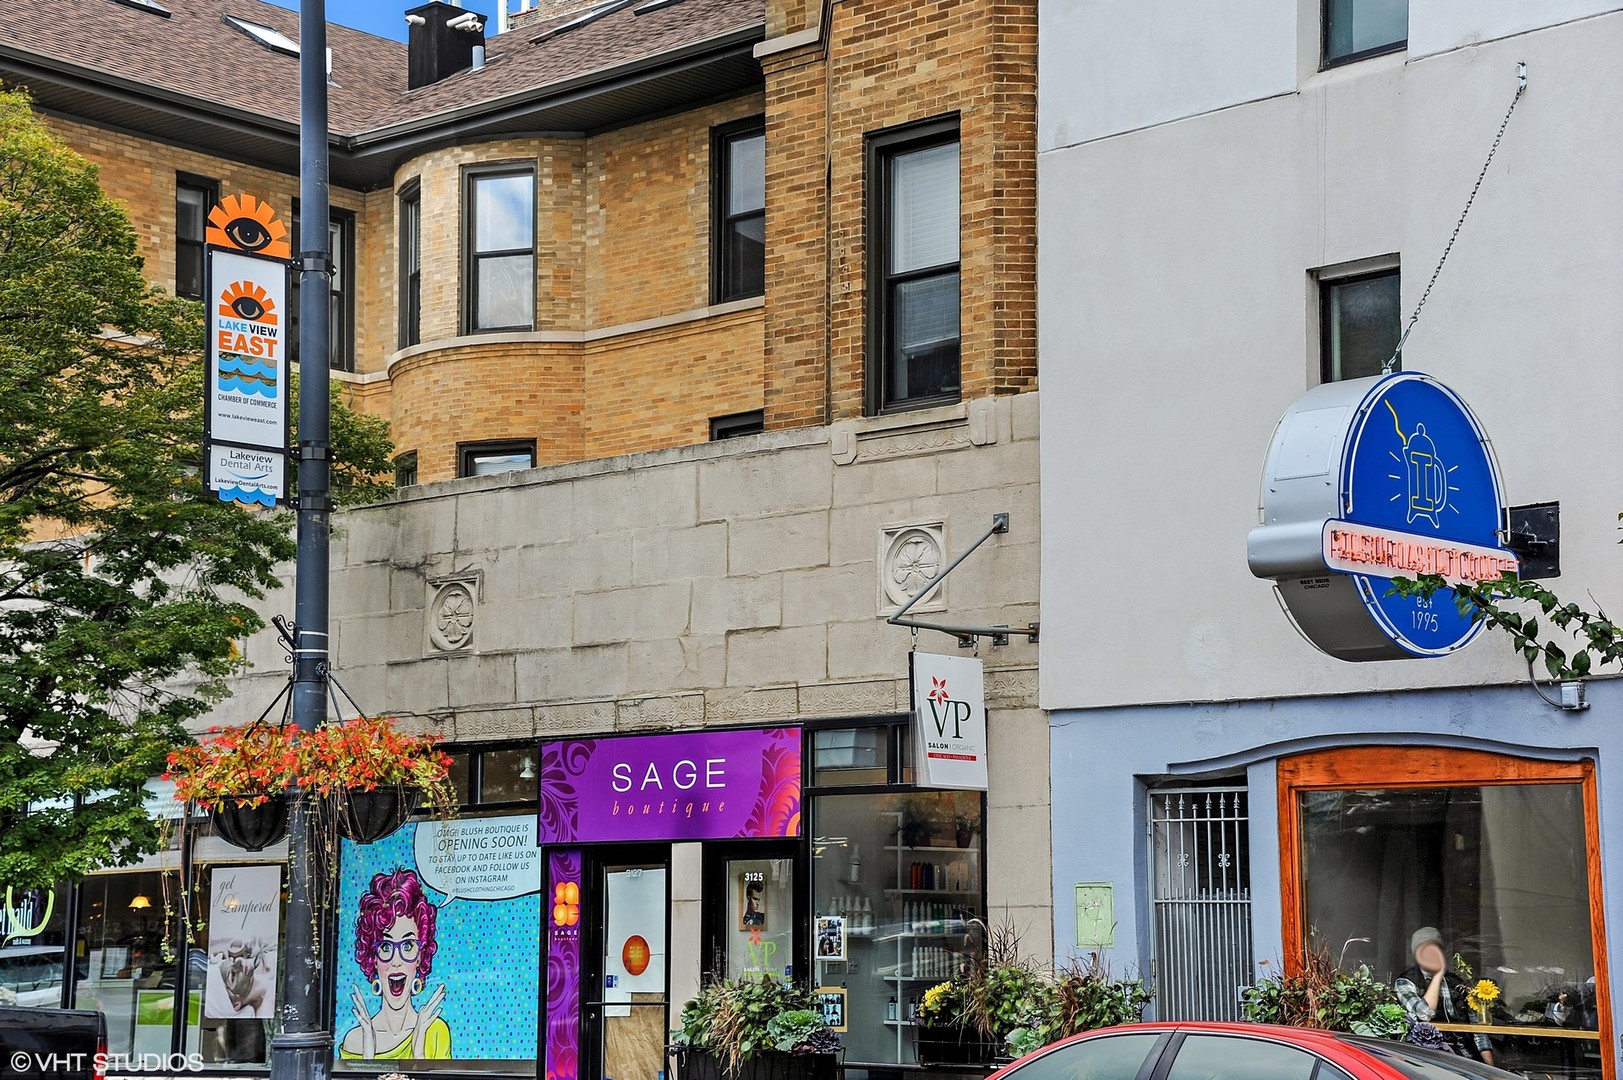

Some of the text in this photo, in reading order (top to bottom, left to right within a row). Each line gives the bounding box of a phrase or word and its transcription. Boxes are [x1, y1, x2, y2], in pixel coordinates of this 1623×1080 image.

[219, 330, 278, 358] EAST
[217, 393, 277, 409] CHAMBER OF COMMERCE
[218, 412, 278, 425] www.lakevieweast.com
[230, 450, 273, 464] Lakeview
[220, 458, 273, 473] Dental Arts
[1411, 610, 1439, 632] 1995
[927, 697, 972, 739] VP
[928, 742, 949, 750] SALON
[611, 758, 726, 793] SAGE
[612, 798, 726, 818] boutique
[461, 827, 483, 836] BLUSH
[485, 825, 520, 834] BOUTIQUE
[521, 824, 529, 832] IS
[438, 835, 528, 851] OPENING SOON!
[429, 850, 537, 864] TO STAY UP TO DATE LIKE US ON
[435, 861, 530, 875] FACEBOOK AND FOLLOW US
[455, 874, 508, 885] ON INSTAGRAM
[744, 872, 764, 882] 3125
[748, 941, 777, 967] VP
